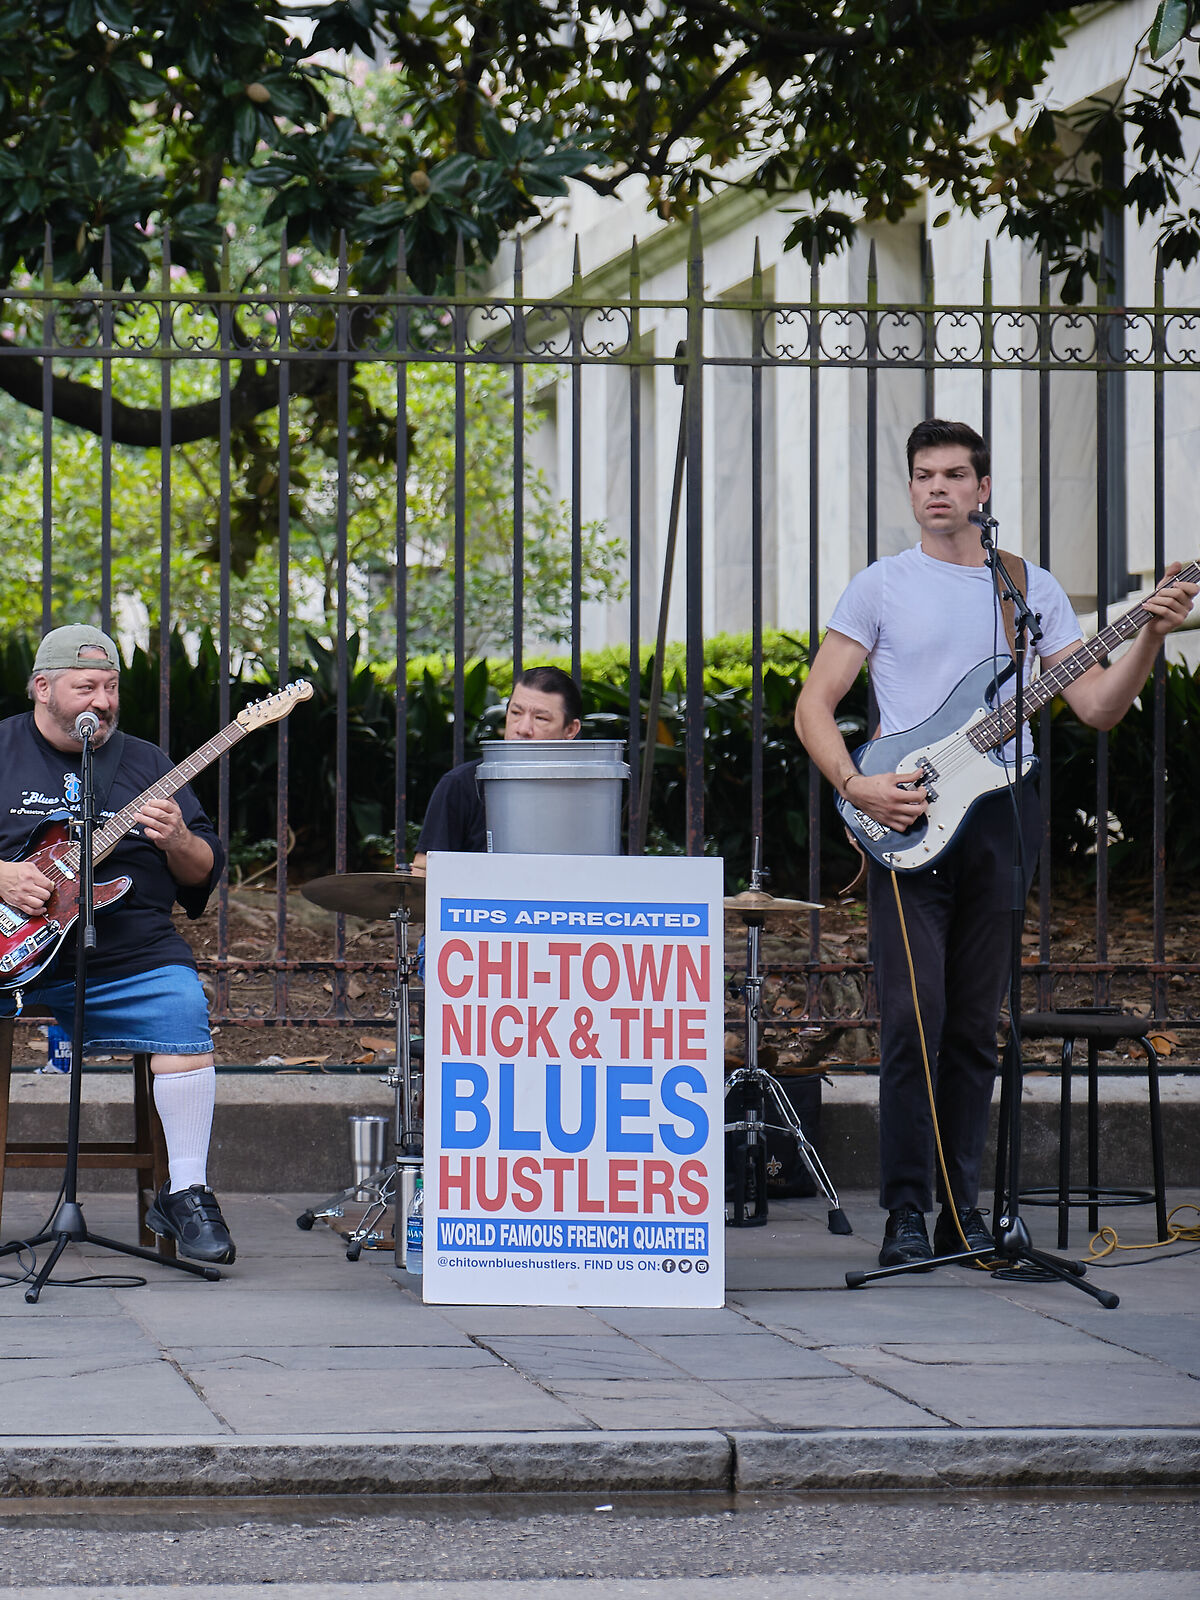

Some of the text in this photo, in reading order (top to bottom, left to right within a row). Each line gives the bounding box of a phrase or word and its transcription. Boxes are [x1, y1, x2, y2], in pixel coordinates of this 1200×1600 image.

[448, 908, 701, 928] TIPS APPRECIATED
[437, 938, 711, 1003] CHI-TOWN
[441, 1004, 708, 1061] NICK & THE
[440, 1062, 710, 1155] BLUES
[438, 1155, 710, 1216] HUSTLERS
[437, 1256, 660, 1271] @chitownblueshustlers. FIND US ON:
[440, 1222, 705, 1250] WORLD FAMOUS FRENCH QUARTER
